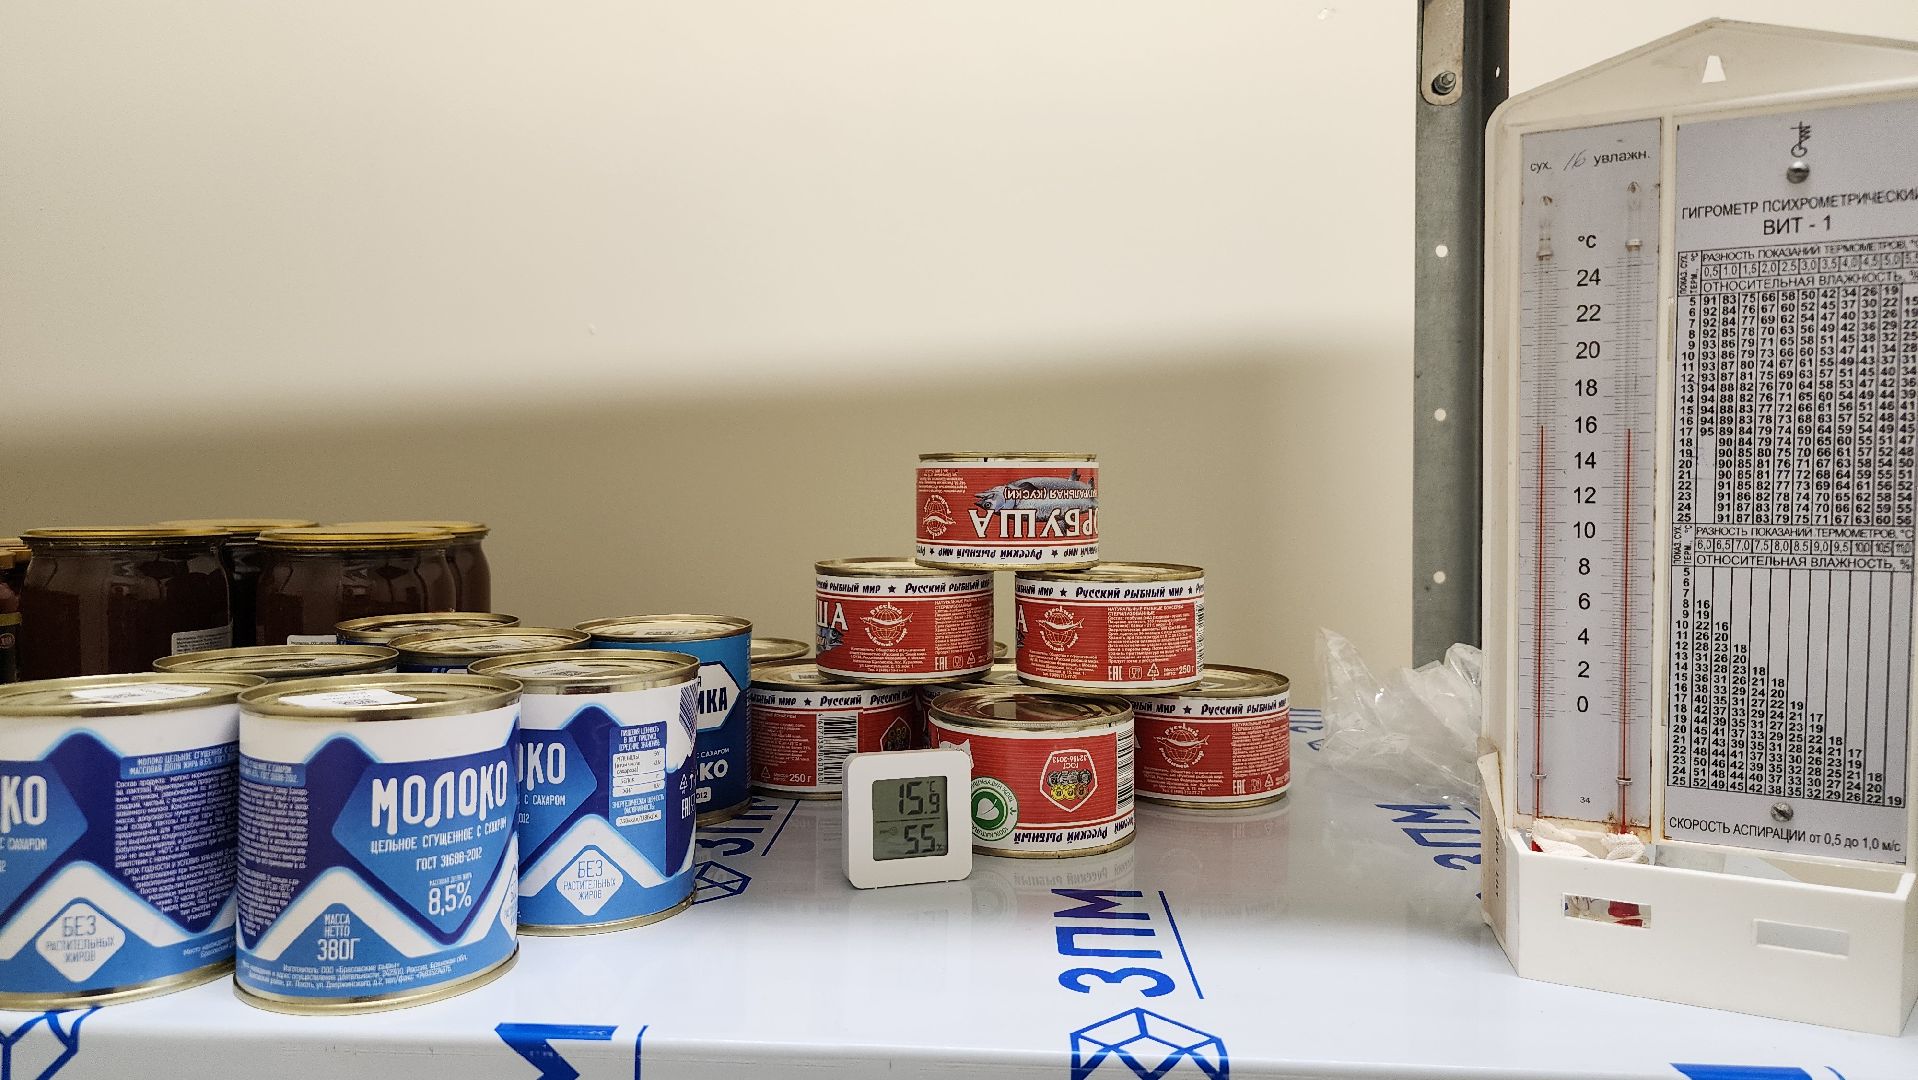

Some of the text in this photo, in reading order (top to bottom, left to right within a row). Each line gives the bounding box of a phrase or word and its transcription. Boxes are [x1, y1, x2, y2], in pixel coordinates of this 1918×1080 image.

[1530, 161, 1552, 173] сух.
[1593, 150, 1650, 167] увлажн.
[1682, 202, 1759, 219] ГИГРОМЕТР
[1763, 217, 1801, 235] ВИТ
[1823, 214, 1831, 231] 1
[1577, 235, 1597, 248] °C
[1703, 251, 1755, 263] РАЗНОСТЬ
[1758, 246, 1820, 260] ПОКАЗАНИЙ
[1576, 268, 1601, 287] 24
[1703, 276, 1815, 294] ОТНОСИТЕЛЬНАЯ
[1576, 304, 1601, 323] 22
[1575, 341, 1601, 360] 20
[1575, 378, 1598, 397] 18
[1575, 415, 1597, 434] 16
[1574, 451, 1597, 469] 14
[1679, 458, 1914, 468] 20 90 85 81 76 71 67 63 58 54 50
[1574, 486, 1597, 504] 12
[1574, 521, 1597, 539] 10
[1697, 527, 1747, 536] РАЗНОСТЬ
[1751, 527, 1812, 538] ПОКАЗАНИЙ
[1578, 558, 1591, 576] 8
[1697, 554, 1808, 566] ОТНОСИТЕЛЬНАЯ
[1578, 594, 1591, 611] 6
[1577, 628, 1590, 646] 4
[1577, 662, 1590, 680] 2
[1576, 696, 1589, 714] 0
[789, 773, 806, 782] 250
[371, 760, 508, 836] МОЛОКО
[532, 795, 567, 807] САХАРОМ
[371, 815, 508, 856] ЦЕЛЬНОЕ СГУЩЕННОЕ С САХАРОМ
[904, 824, 935, 854] 55
[1670, 817, 1730, 834] СКОРОСТЬ
[1733, 823, 1806, 844] АСПИРАЦИИ
[1809, 832, 1820, 842] от
[1824, 831, 1841, 847] 0,5
[1844, 836, 1857, 848] до
[1862, 836, 1879, 851] 1,0
[416, 853, 438, 873] ГОСТ
[578, 861, 604, 879] БЕЗ
[563, 879, 617, 892] РАСТИТЕЛЬНЫХ
[428, 880, 473, 917] 8,5%
[578, 890, 603, 902] ЖИРОВ
[62, 915, 97, 938] БЕЗ
[324, 913, 351, 926] МАССА
[324, 925, 351, 938] НЕТТО
[46, 935, 115, 953] РАСТИТЕЛЬНЫХ
[1051, 889, 1177, 998] ЗПМ
[64, 949, 96, 963] ЖИРОВ
